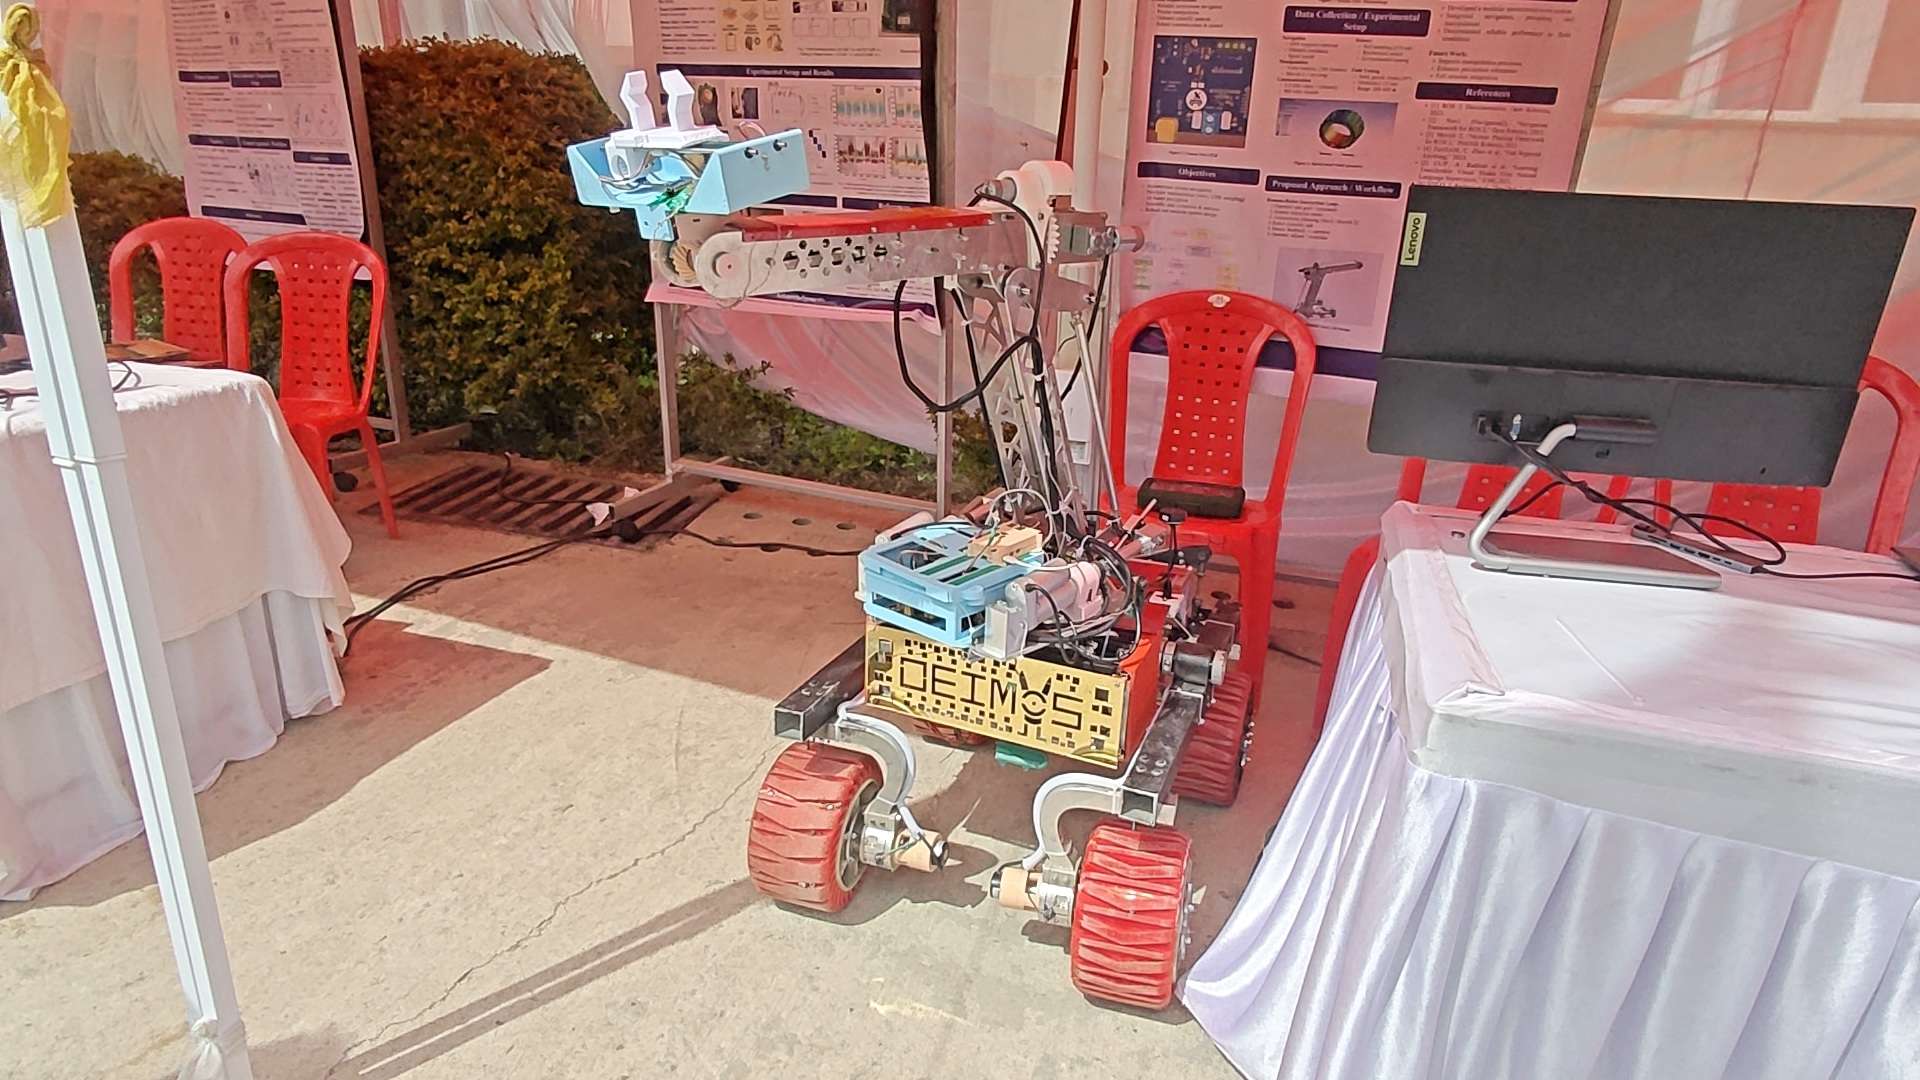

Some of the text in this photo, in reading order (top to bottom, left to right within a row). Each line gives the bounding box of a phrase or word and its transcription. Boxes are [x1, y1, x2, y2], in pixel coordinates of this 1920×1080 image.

[1295, 10, 1315, 18] Data
[1316, 11, 1357, 19] Collection
[1364, 12, 1421, 22] Experimental
[1343, 23, 1367, 32] Setup
[1465, 88, 1511, 98] References
[1178, 168, 1217, 178] Objectives
[1272, 180, 1308, 190] Proposed
[1310, 182, 1348, 192] Approach
[1354, 184, 1395, 194] Workflow
[1404, 217, 1421, 261] Lenovo
[900, 656, 1084, 731] DEIMOS
